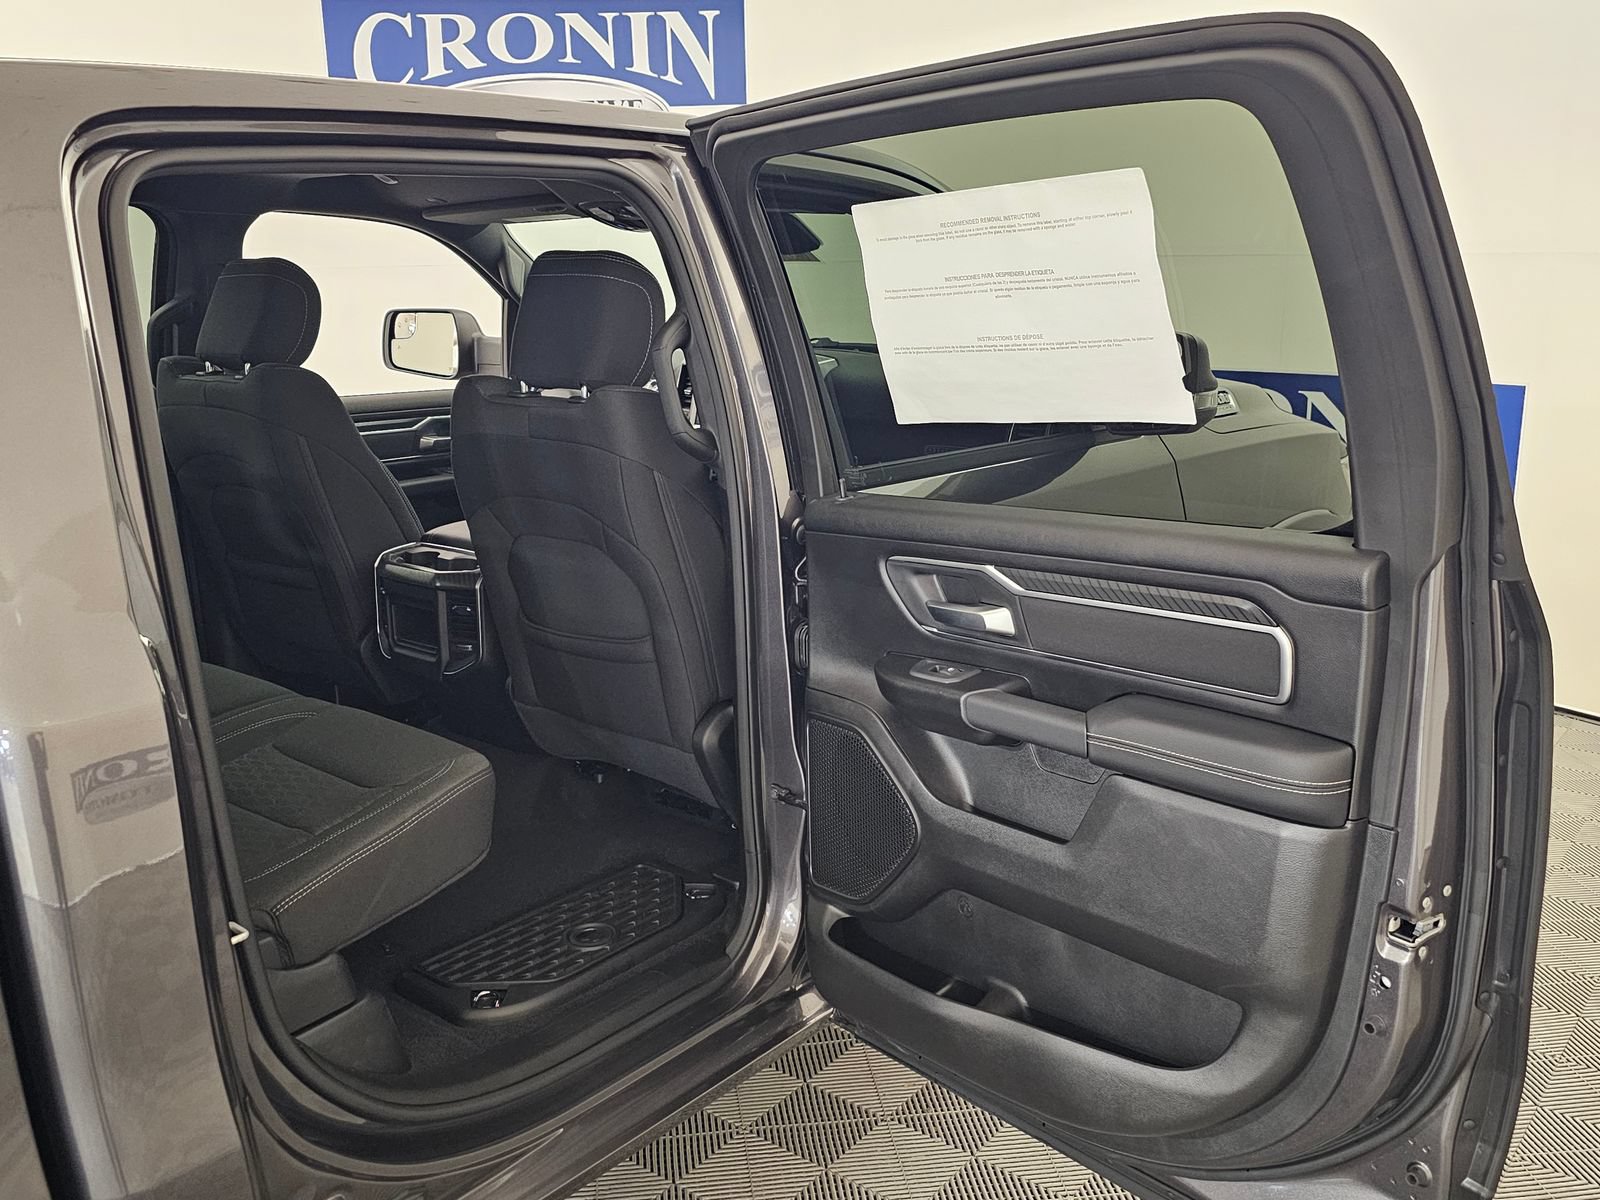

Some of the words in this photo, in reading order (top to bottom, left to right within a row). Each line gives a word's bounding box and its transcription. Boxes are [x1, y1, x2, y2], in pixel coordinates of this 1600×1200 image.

[353, 10, 720, 100] CRONIN
[940, 218, 979, 228] RECOMMENDED
[980, 216, 1003, 224] REMOVAL
[1003, 212, 1040, 221] INSTRUCTIONS
[944, 274, 981, 283] INSTRUCCIONES
[981, 272, 995, 280] PARA
[995, 270, 1025, 278] DESPRENDER
